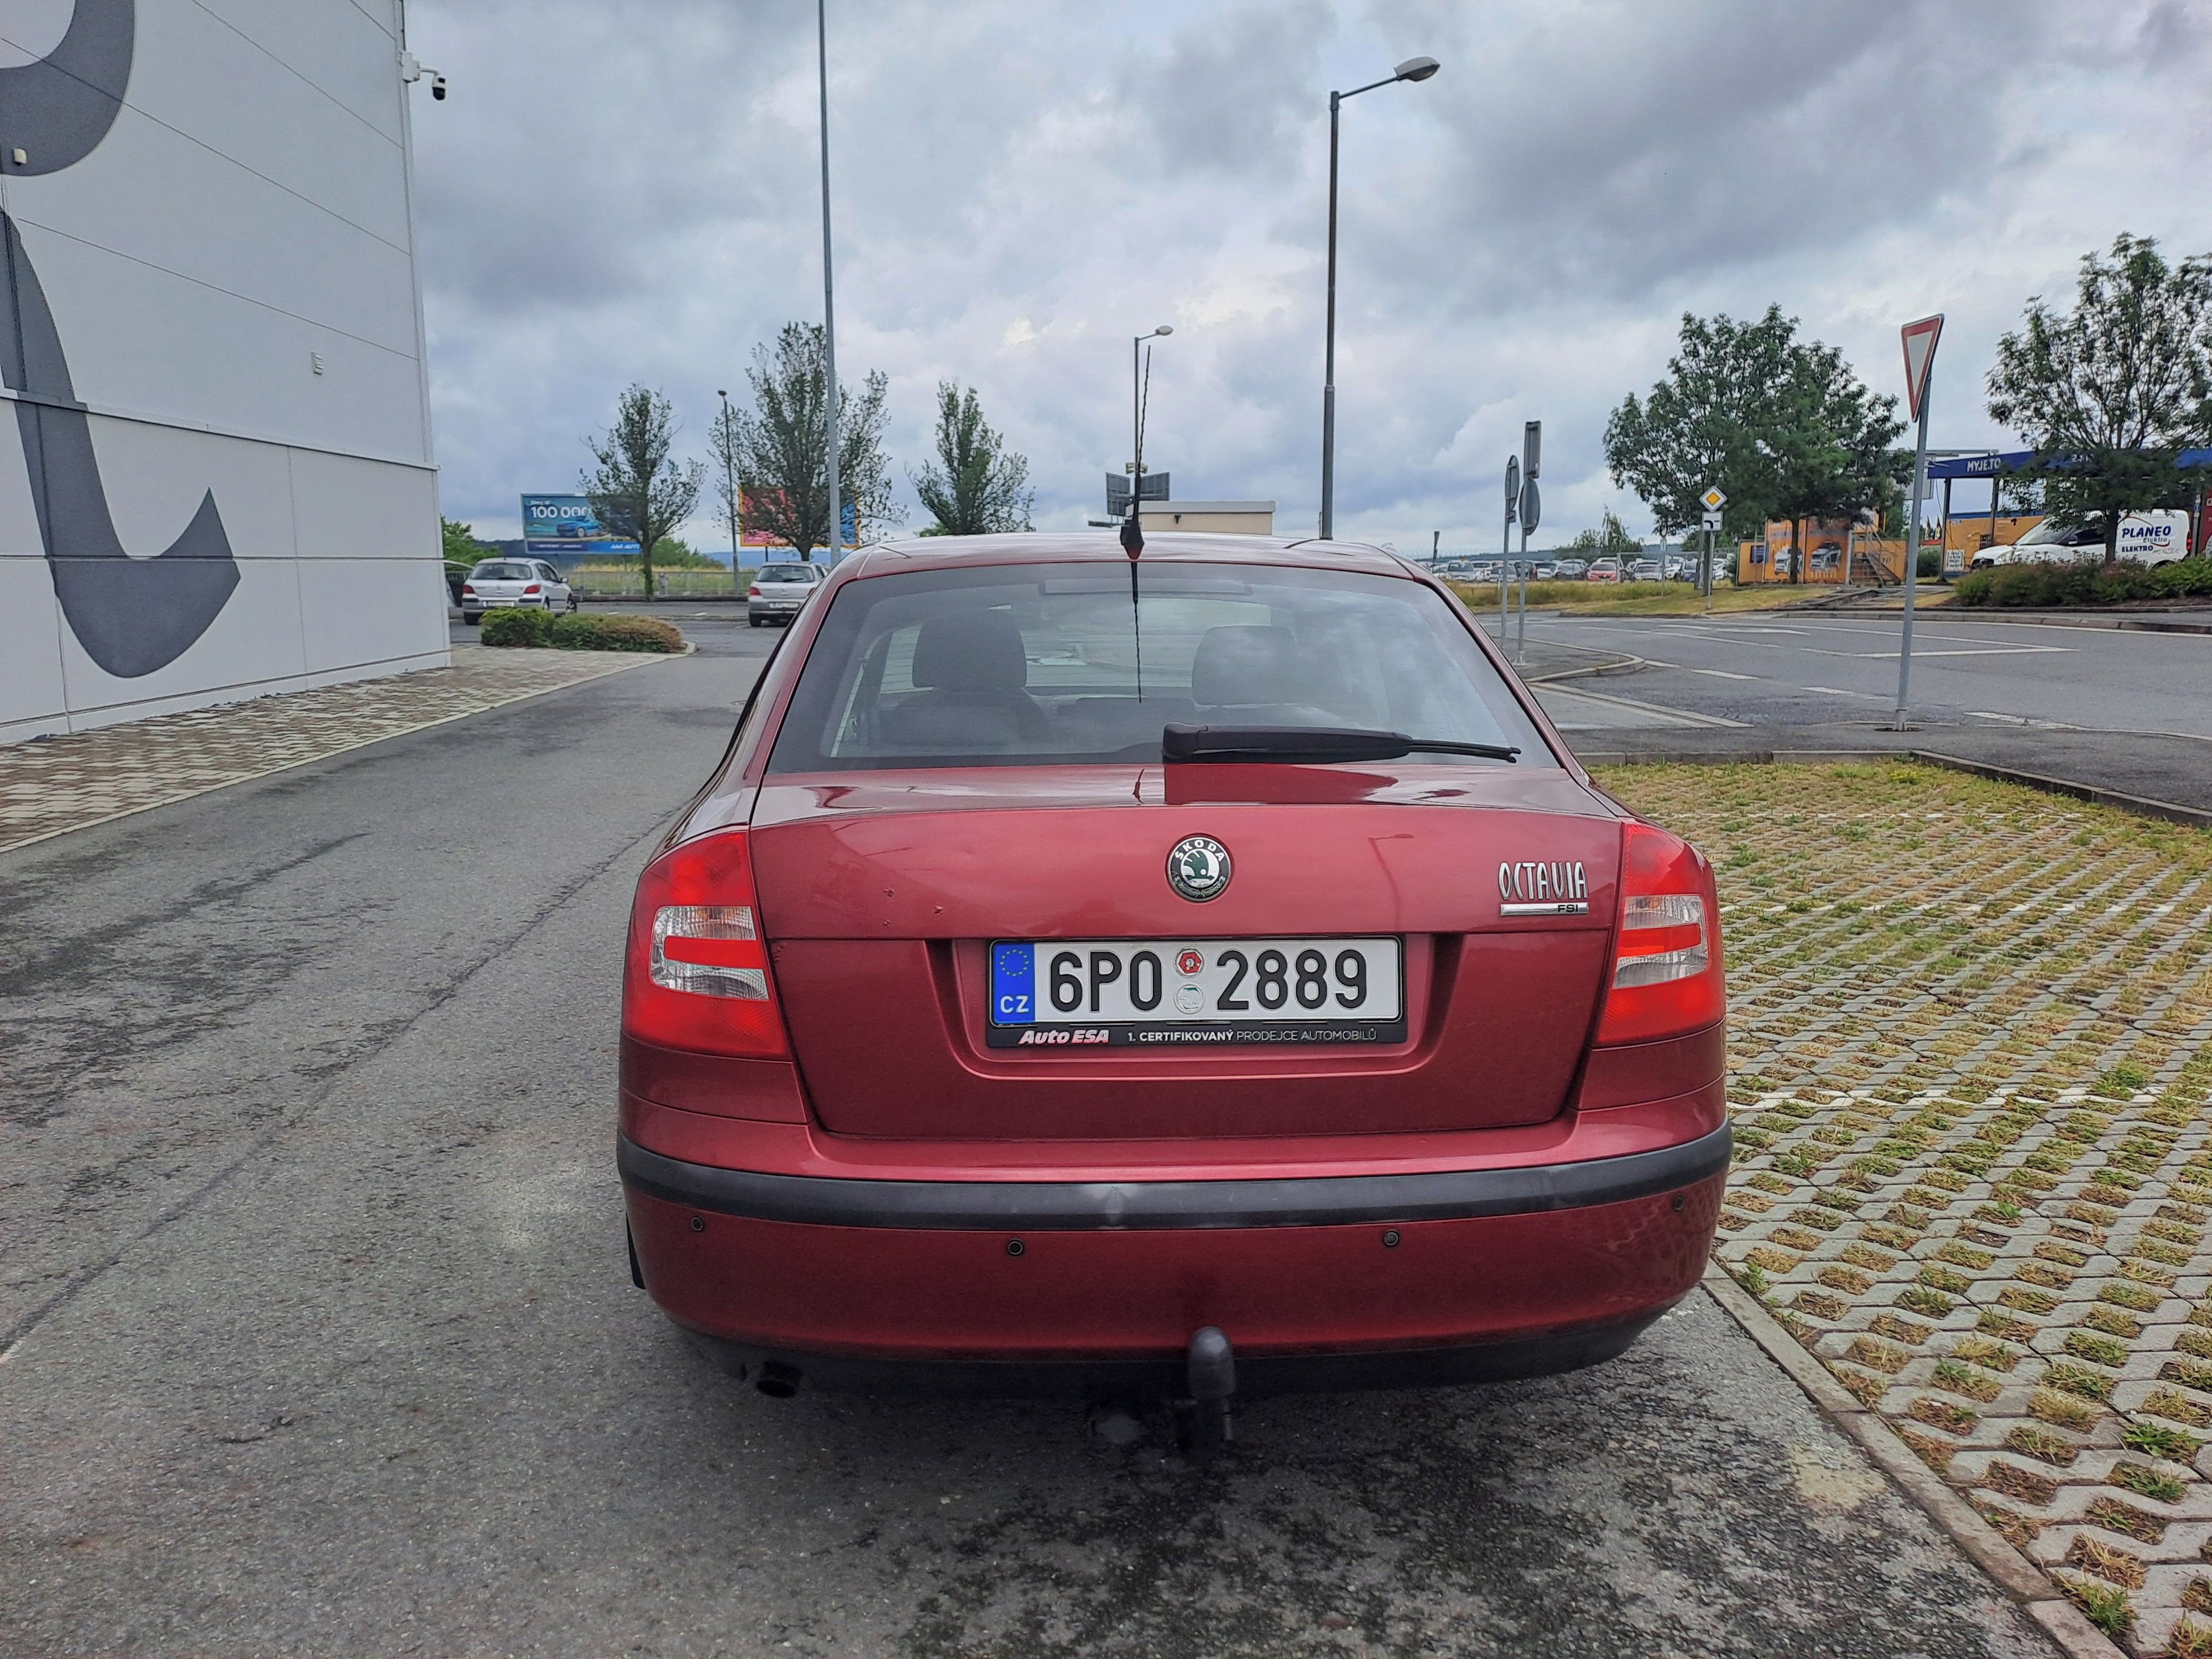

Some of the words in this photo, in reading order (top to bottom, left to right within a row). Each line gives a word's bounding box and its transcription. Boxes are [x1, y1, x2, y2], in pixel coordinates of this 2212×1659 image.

[530, 506, 558, 519] 100
[2122, 525, 2172, 539] PLANEO
[1499, 862, 1588, 900] OCTAVIA
[1557, 904, 1579, 912] FSI
[1050, 951, 1162, 1012] 6P0
[1216, 949, 1367, 1010] 2889
[1000, 995, 1029, 1014] CZ
[1018, 1030, 1070, 1045] Auto
[1071, 1030, 1109, 1044] ESA
[1128, 1032, 1136, 1042] 1.
[1139, 1029, 1233, 1042] CERTIFIKOVANÝ
[1237, 1030, 1298, 1041] PRODEJCE
[1301, 1027, 1377, 1041] AUTOMOBILŮ
